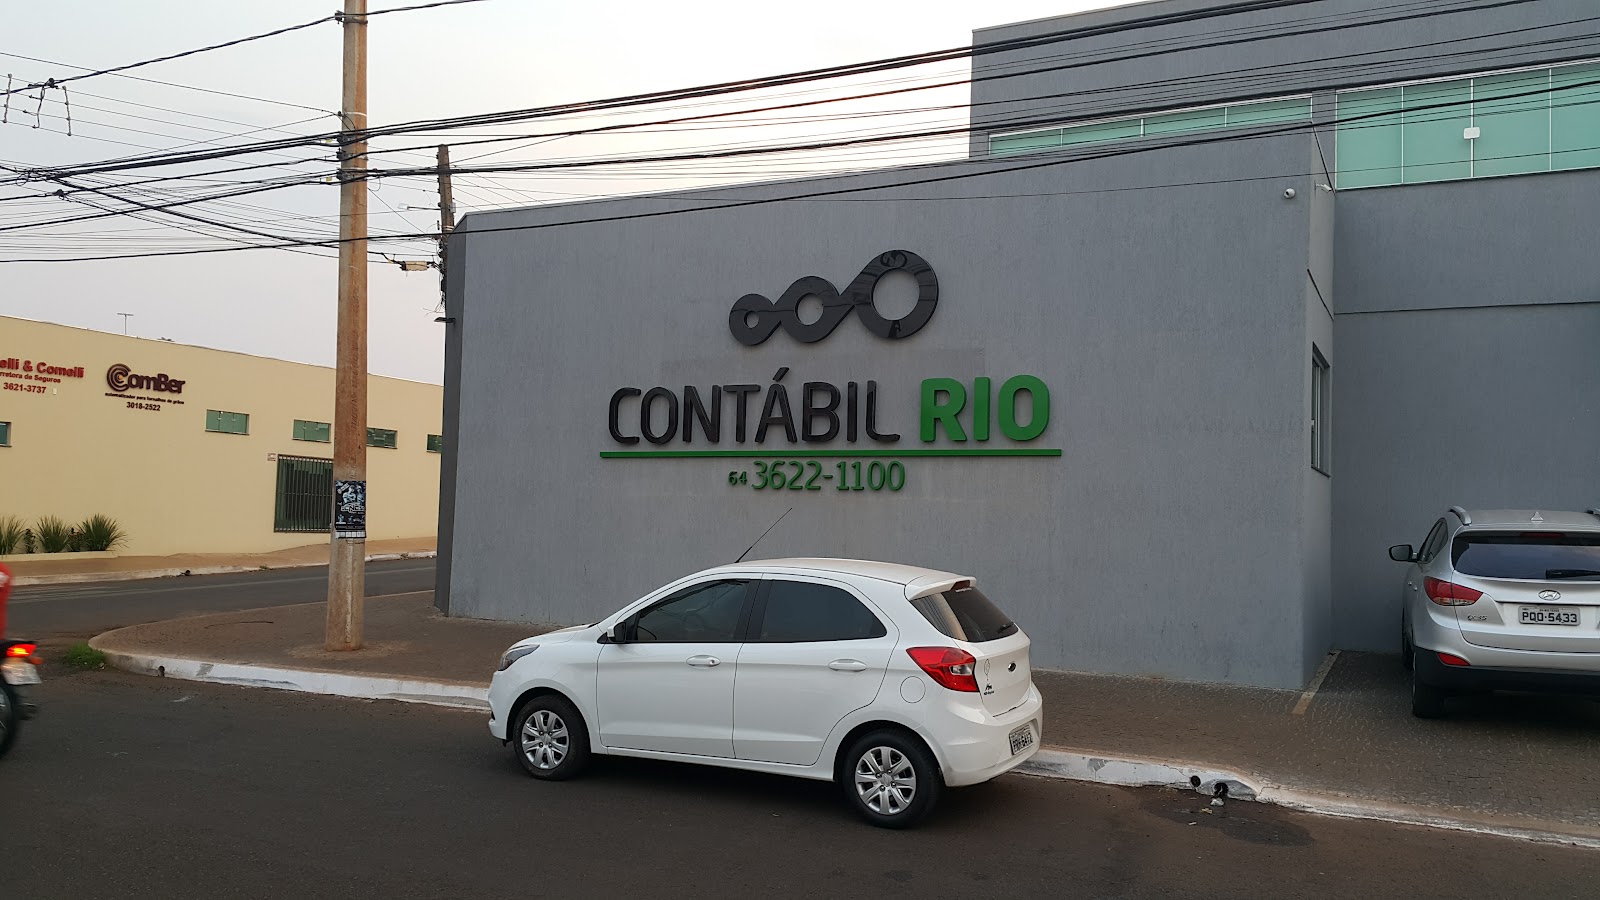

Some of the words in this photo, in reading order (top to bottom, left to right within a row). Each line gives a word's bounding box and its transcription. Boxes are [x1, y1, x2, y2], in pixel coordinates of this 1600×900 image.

[23, 359, 33, 372] &
[36, 361, 85, 379] Comelli
[34, 374, 61, 383] Seguros
[106, 363, 186, 394] ComBer
[3, 382, 47, 394] 3621-3737
[126, 401, 161, 412] 3018-2522
[608, 366, 901, 445] CONTÁBIL
[919, 374, 1051, 443] RIO
[727, 470, 748, 486] 64
[750, 459, 906, 491] 3622-1100
